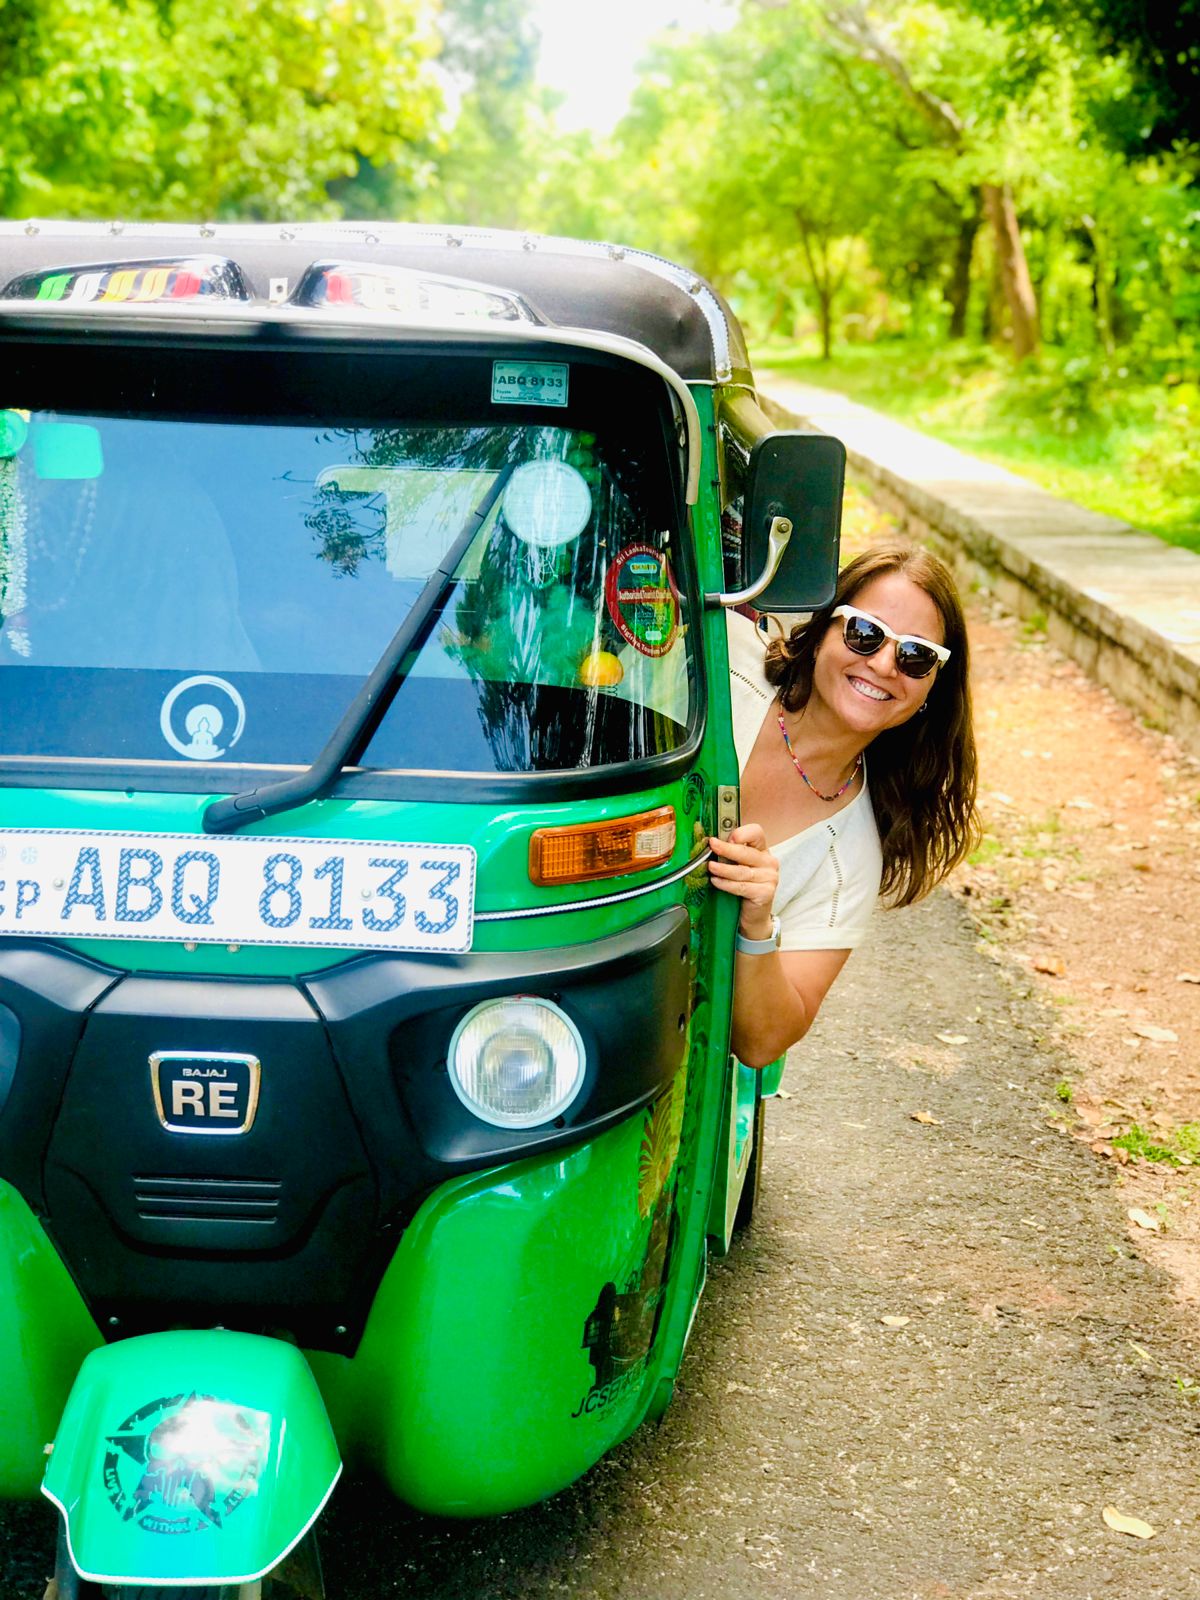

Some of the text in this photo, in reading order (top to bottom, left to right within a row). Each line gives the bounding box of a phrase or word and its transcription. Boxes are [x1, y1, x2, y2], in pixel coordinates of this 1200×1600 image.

[497, 375, 563, 388] ABQ 8133
[60, 846, 461, 934] ABQ 8133
[182, 1068, 228, 1078] BAJAJ
[172, 1080, 239, 1118] RE
